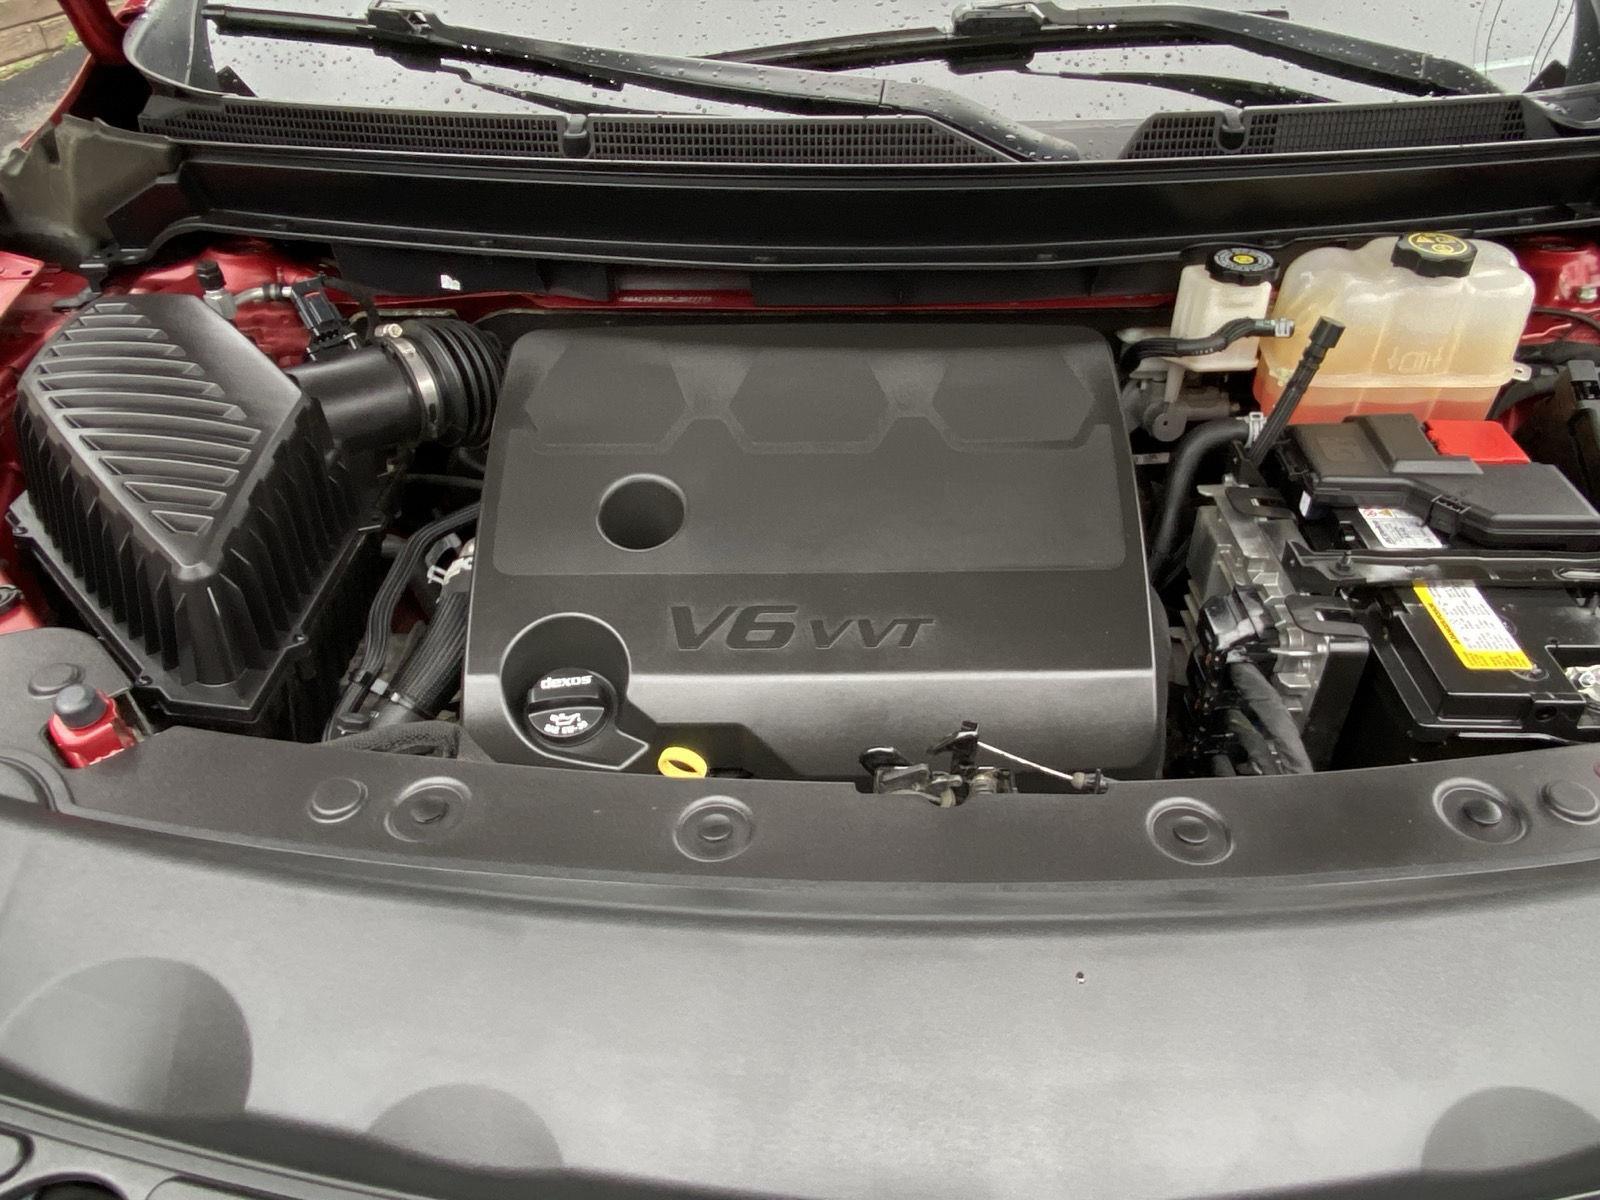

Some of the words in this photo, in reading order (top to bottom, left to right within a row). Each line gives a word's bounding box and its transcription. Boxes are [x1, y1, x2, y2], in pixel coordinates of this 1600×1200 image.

[670, 605, 798, 650] V6
[809, 618, 936, 649] VVT
[540, 675, 593, 689] dexos
